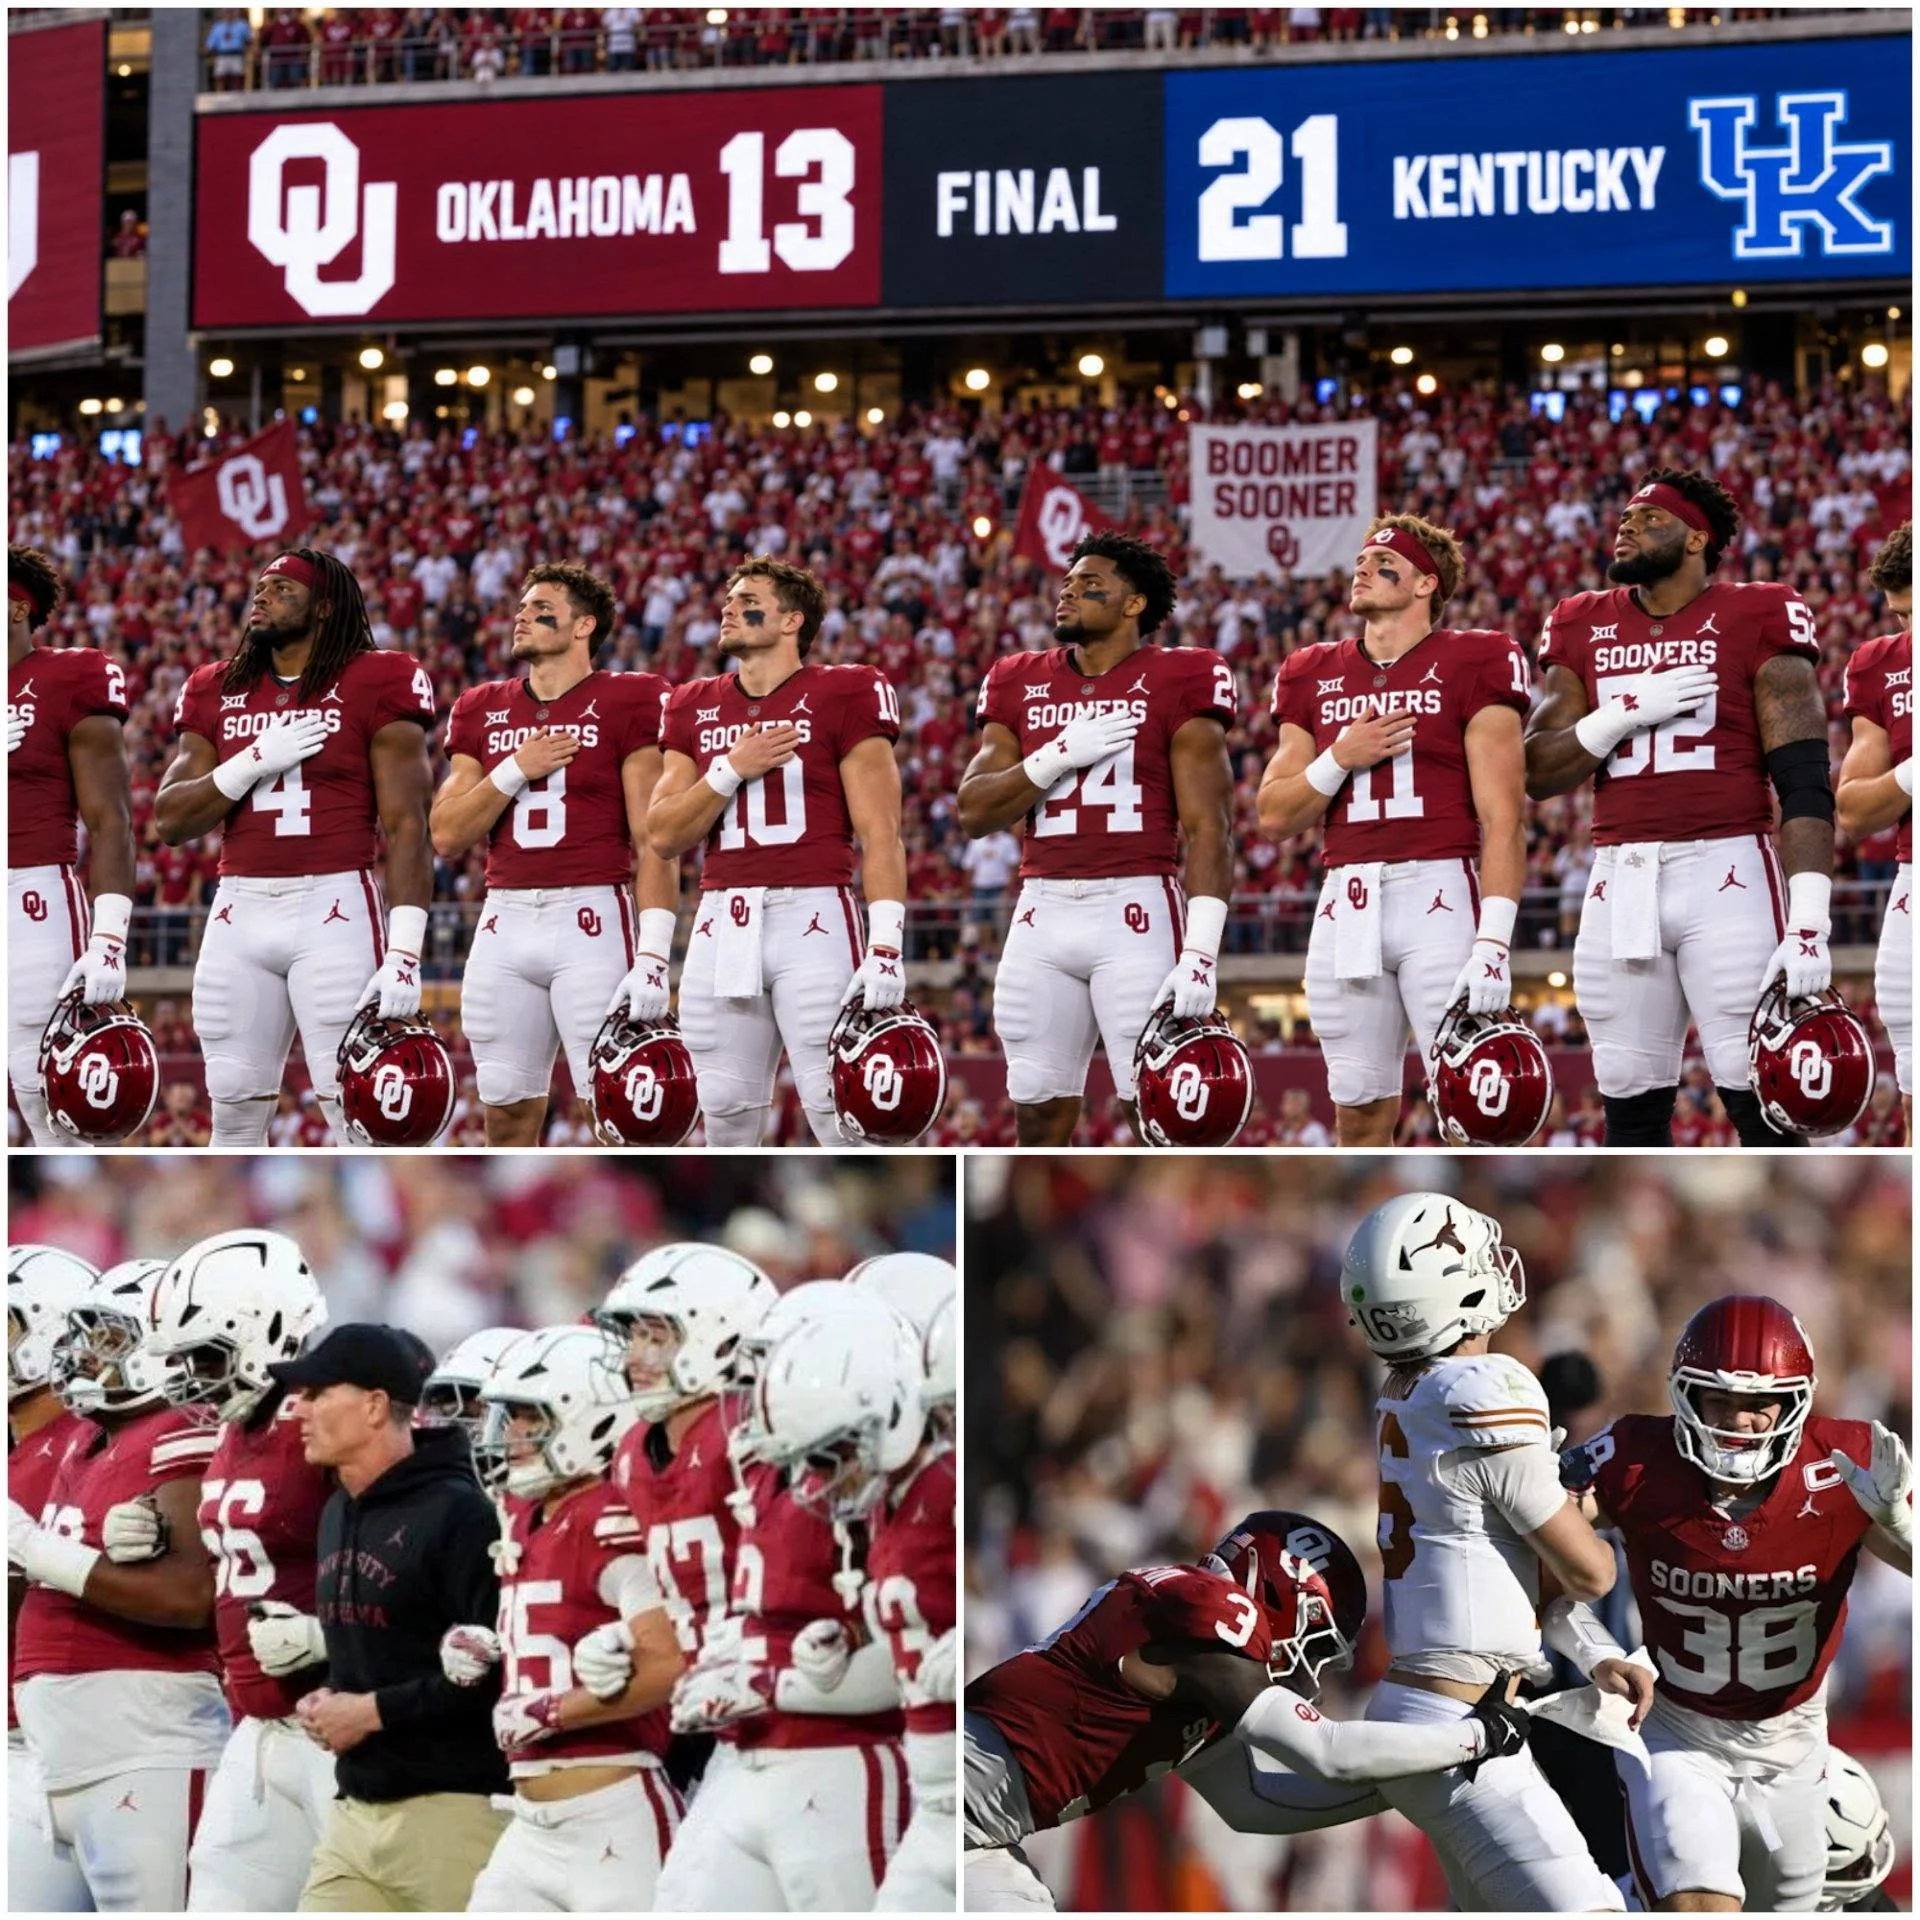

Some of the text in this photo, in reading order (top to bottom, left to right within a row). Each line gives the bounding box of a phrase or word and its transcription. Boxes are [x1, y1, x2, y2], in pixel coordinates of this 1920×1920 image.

[936, 166, 1118, 237] FINAL
[1198, 91, 1894, 261] 21 KENTUCKY UK
[248, 122, 856, 317] OU OKLAHOMA 13
[1208, 436, 1358, 476] BOOMER
[216, 453, 289, 539] OU
[1214, 481, 1356, 519] SOONER
[1268, 524, 1299, 568] OU
[1595, 640, 1717, 672] SOONERS
[223, 708, 342, 741] SOOS
[1321, 690, 1442, 725] SOONERS
[488, 724, 599, 755] SOOERS
[253, 758, 311, 837] 4
[512, 765, 567, 849] 8
[23, 890, 48, 922] OU
[730, 894, 750, 927] OU
[1123, 902, 1150, 934] OU
[1347, 876, 1368, 910] OU
[577, 907, 603, 938] OU
[78, 1052, 119, 1110] OU
[374, 1064, 413, 1121] OU
[624, 1065, 665, 1122] OU
[863, 1053, 903, 1111] OU
[1170, 1062, 1210, 1122] OU
[1469, 1058, 1510, 1118] OU
[1790, 1040, 1832, 1099] OU
[1358, 1307, 1399, 1342] 16
[1650, 1559, 1818, 1600] SOONERS
[1214, 1592, 1258, 1648] 3
[1651, 1596, 1822, 1695] 38
